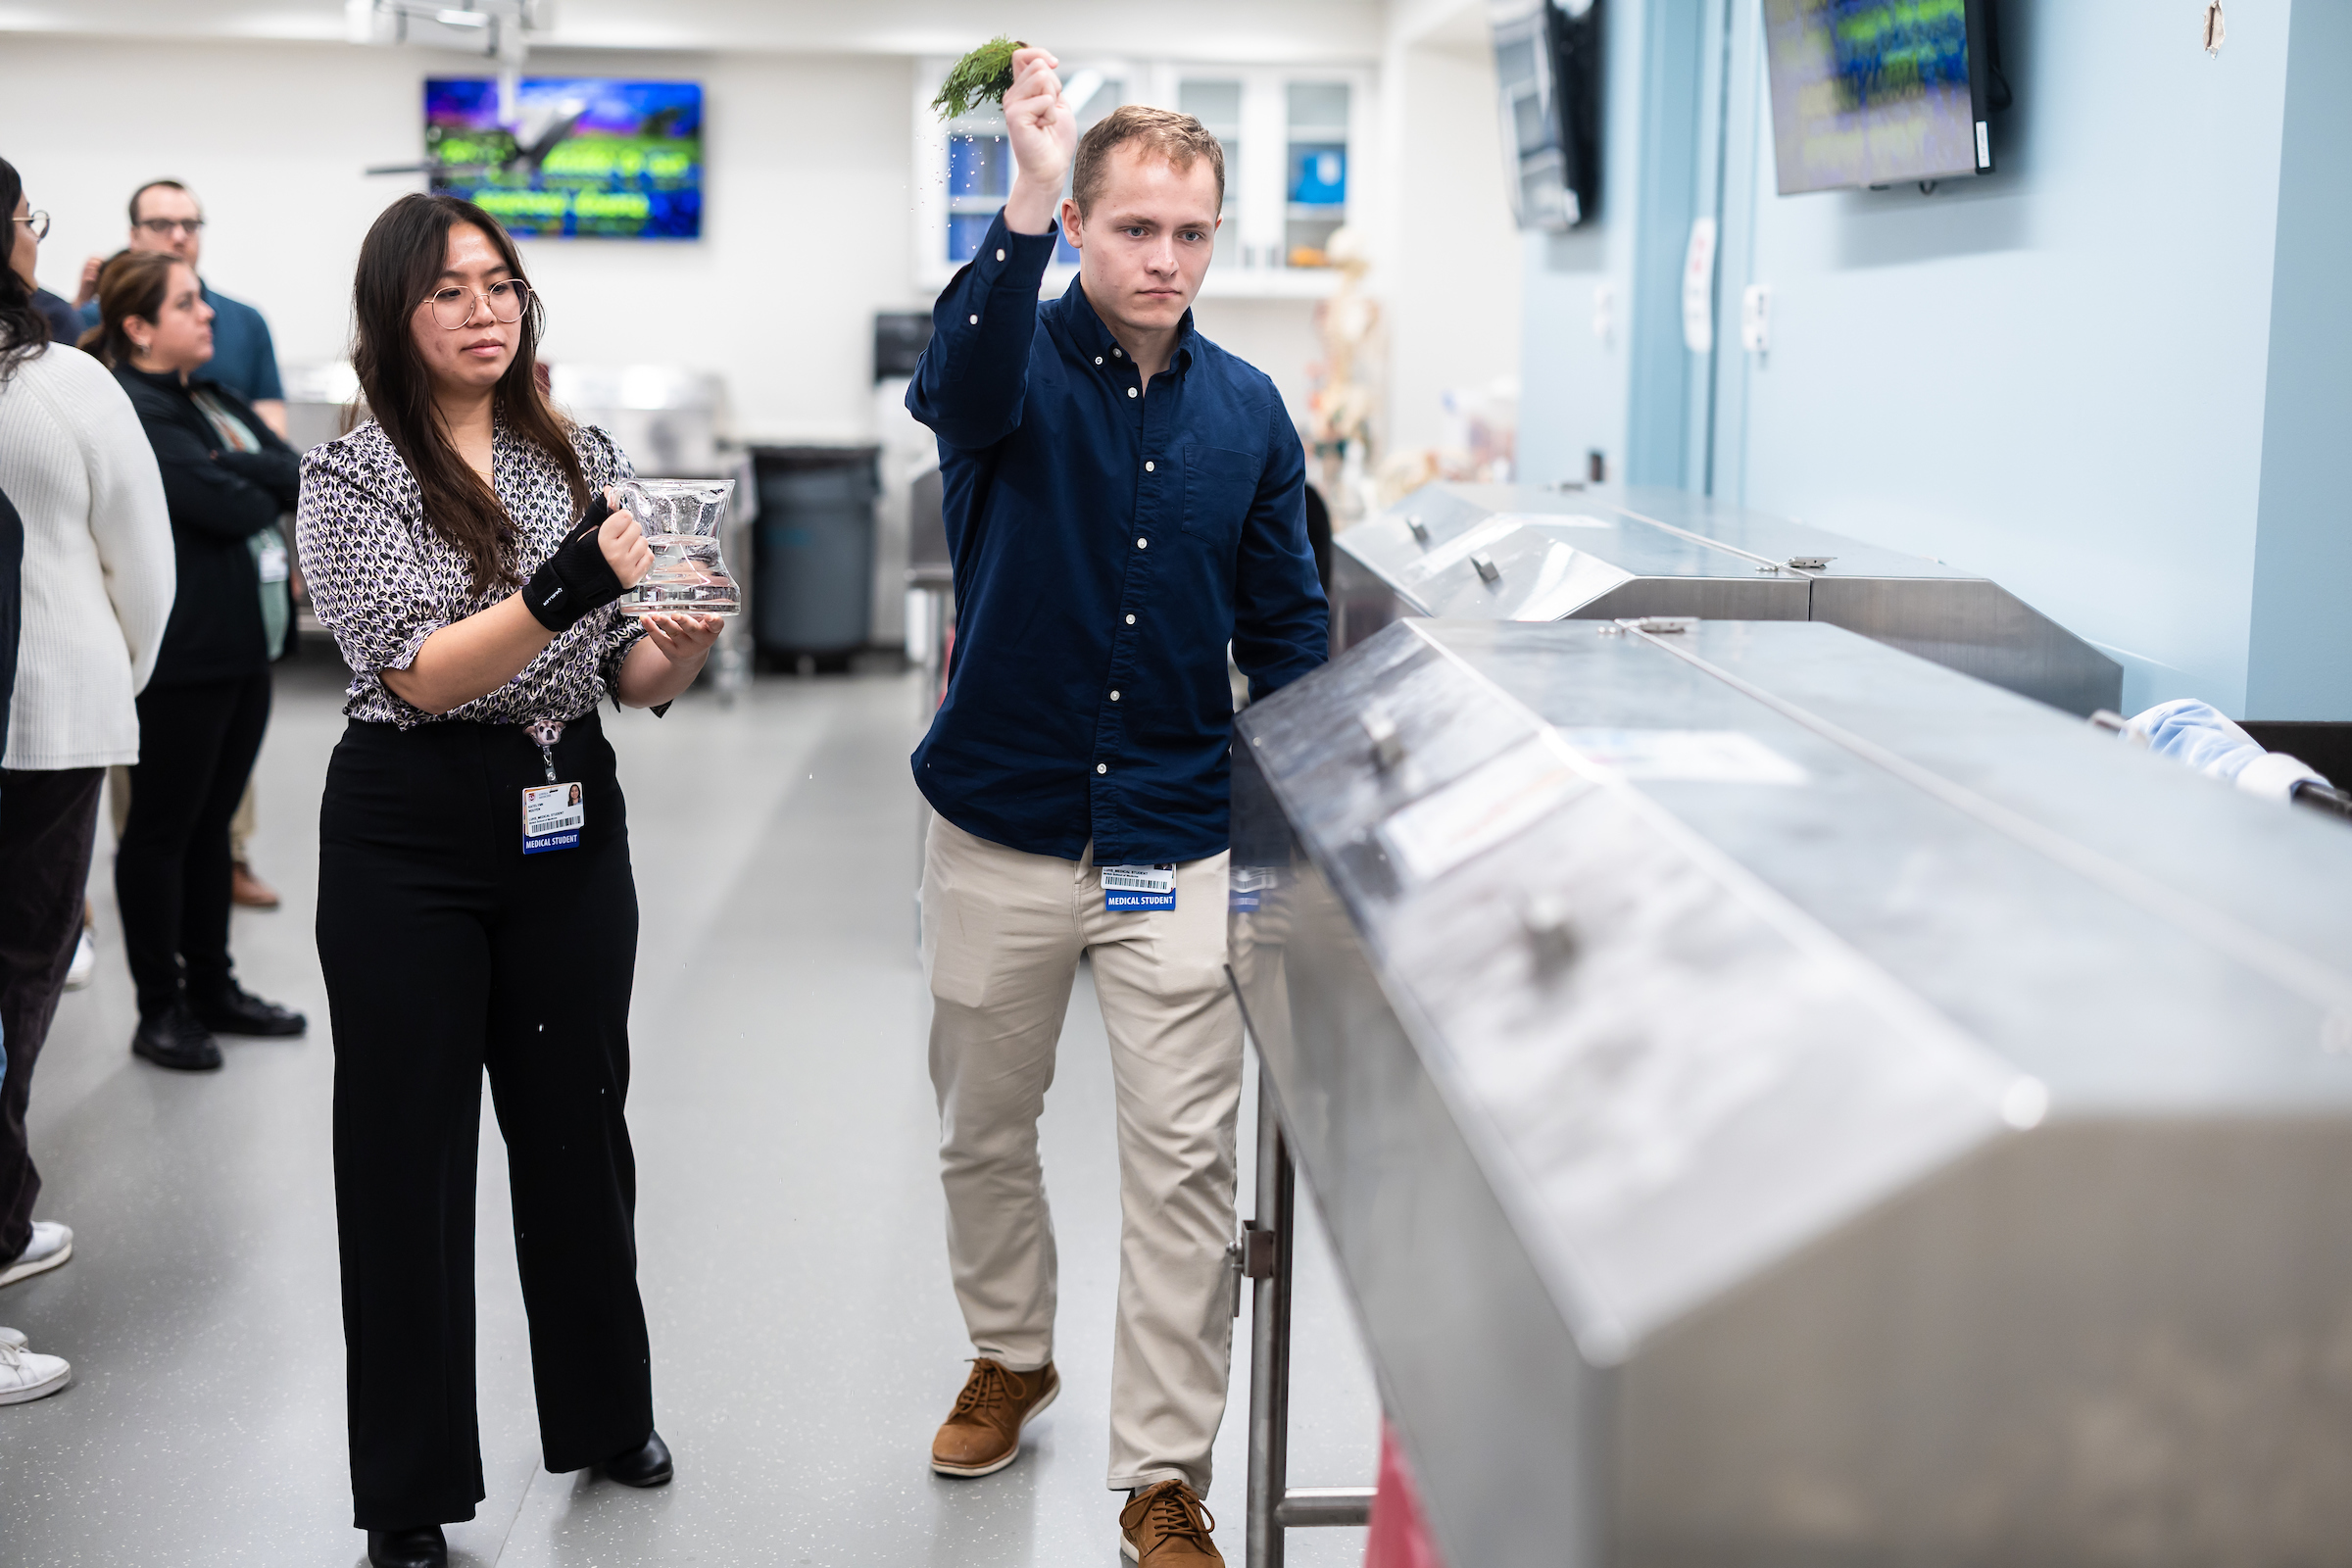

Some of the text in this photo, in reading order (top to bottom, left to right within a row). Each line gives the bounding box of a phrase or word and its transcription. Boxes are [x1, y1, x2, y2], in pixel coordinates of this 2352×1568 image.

[526, 834, 578, 850] MEDICAL STUDENT
[1108, 896, 1173, 906] MEDICAL STUDENT
